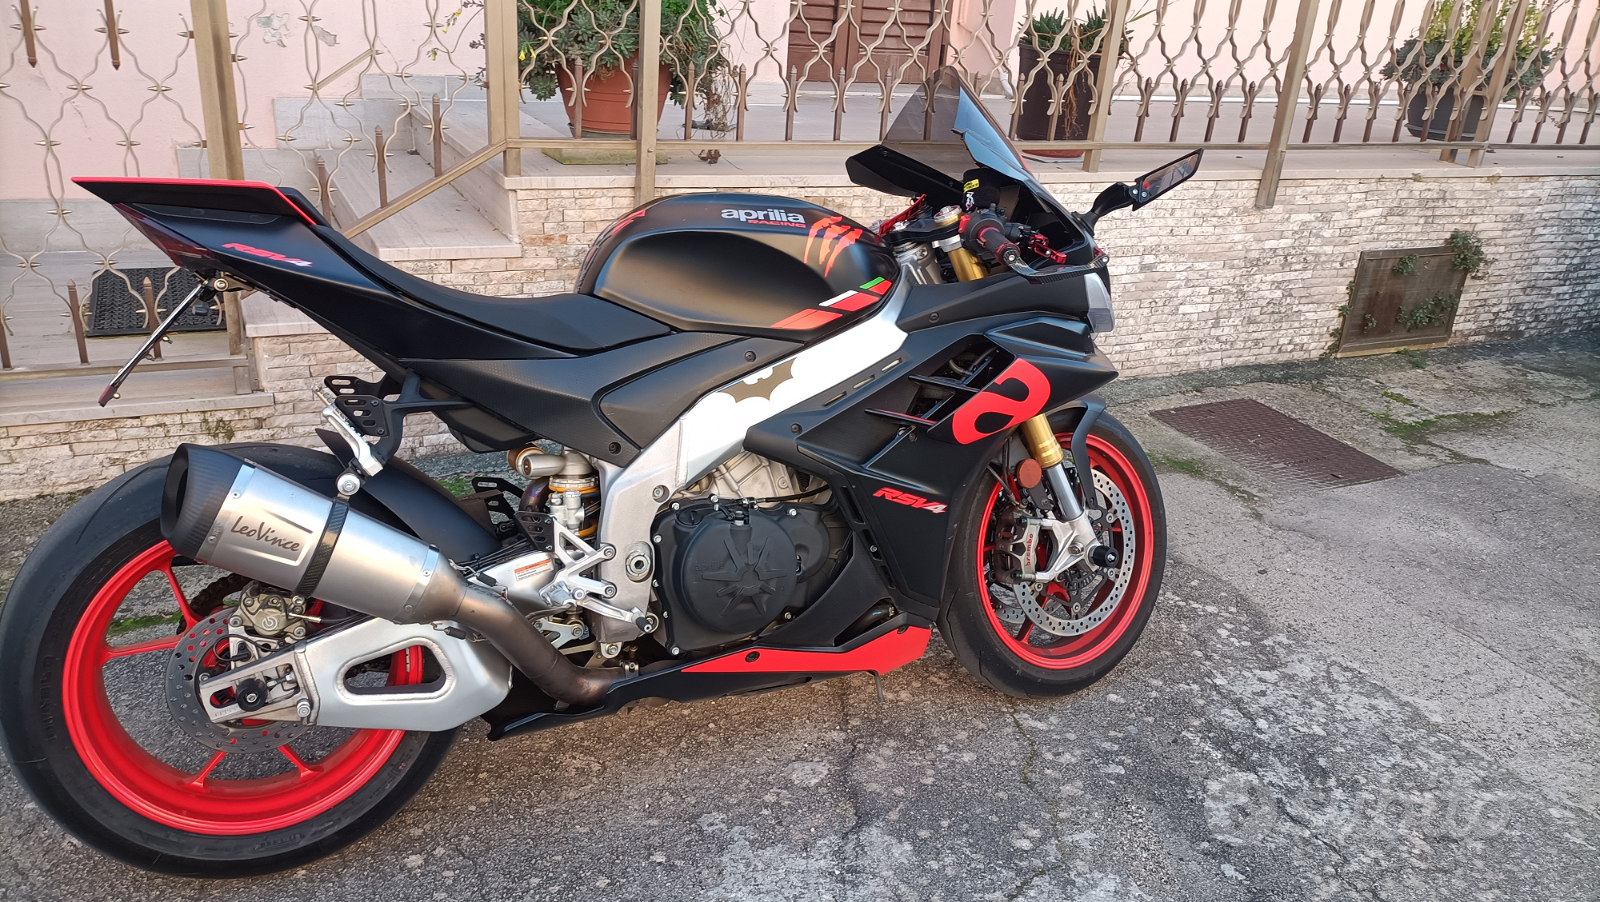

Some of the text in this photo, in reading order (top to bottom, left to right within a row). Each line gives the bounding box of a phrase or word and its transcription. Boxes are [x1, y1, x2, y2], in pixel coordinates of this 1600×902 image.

[721, 208, 806, 223] aprilia
[747, 219, 807, 229] RACING
[222, 242, 313, 267] RSV4
[872, 486, 948, 514] RSV4
[230, 515, 300, 552] LeoVince
[1024, 533, 1034, 567] brembo
